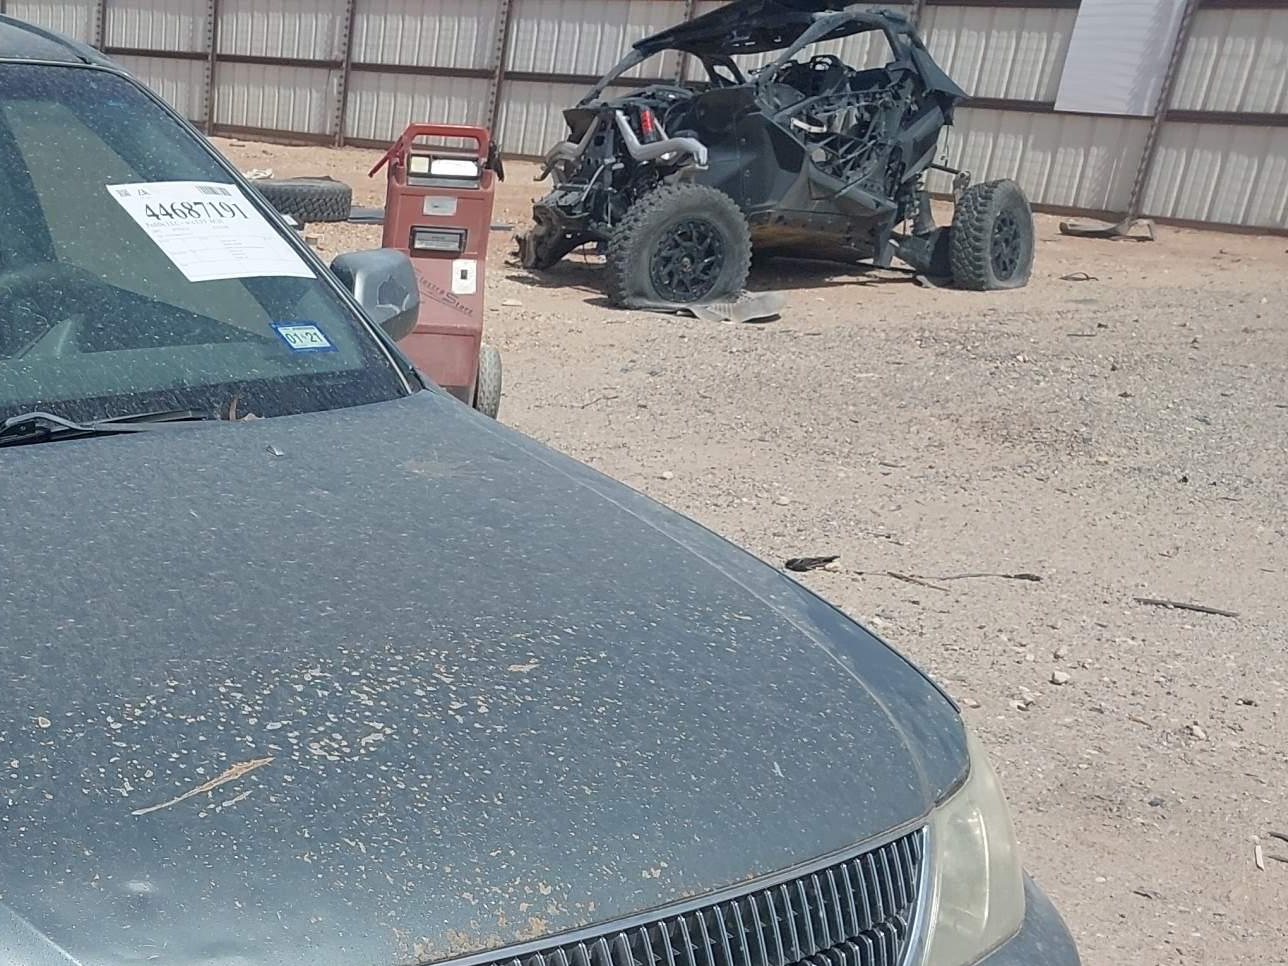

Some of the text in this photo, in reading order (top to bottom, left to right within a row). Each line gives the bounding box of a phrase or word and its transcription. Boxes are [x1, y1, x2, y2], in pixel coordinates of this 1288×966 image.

[144, 201, 249, 221] 44687191
[285, 331, 323, 345] 01 21
